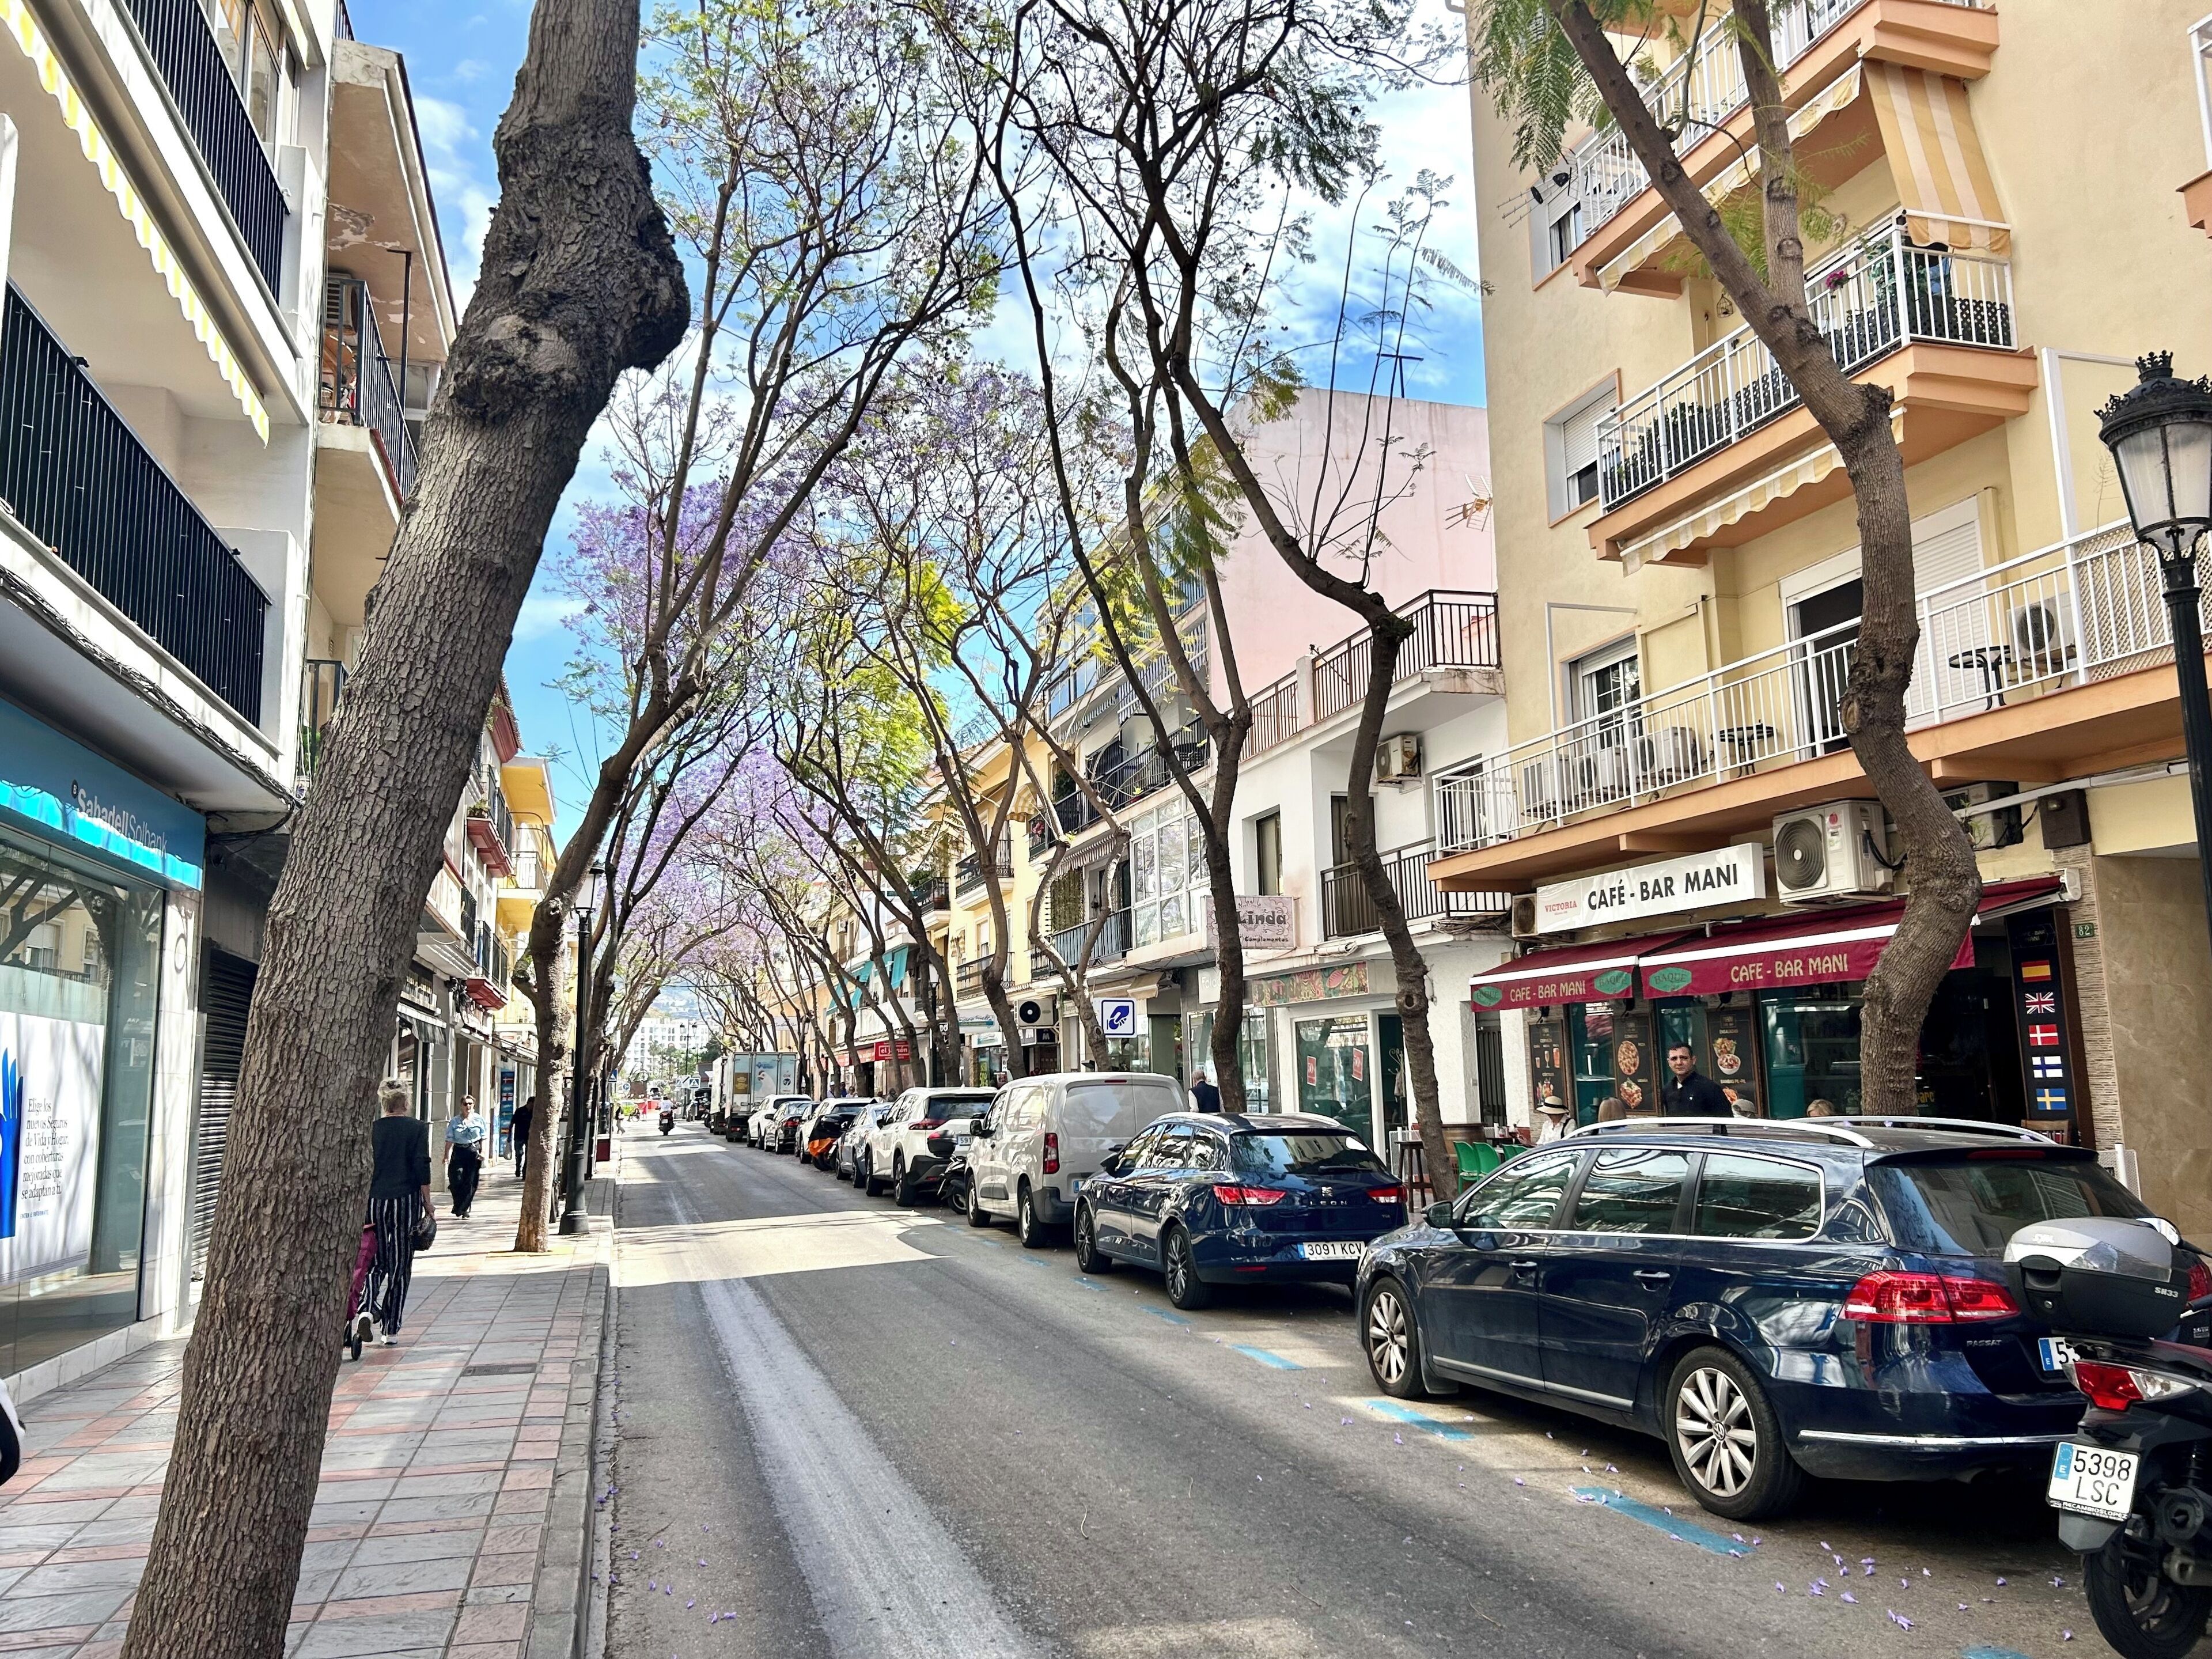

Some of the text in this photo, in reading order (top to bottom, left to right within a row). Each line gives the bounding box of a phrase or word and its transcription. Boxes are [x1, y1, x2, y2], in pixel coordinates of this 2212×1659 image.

[1588, 879, 1626, 910] CAFÉ
[1639, 876, 1675, 902] BAR
[1685, 863, 1738, 893] MANI
[1544, 900, 1578, 912] VICTORIA
[2078, 925, 2090, 936] 82
[1730, 963, 1764, 983] CAFE
[1775, 959, 1804, 979] BAR
[1808, 953, 1849, 975] MANI
[1510, 987, 1531, 1002] CAFE
[1538, 984, 1556, 999] BAR
[1559, 980, 1586, 997] MANI
[28, 1098, 51, 1116] Elige los
[26, 1116, 68, 1133] nuevos Seguros
[25, 1132, 33, 1147] de
[34, 1131, 47, 1146] Vida
[51, 1132, 69, 1148] Hogar,
[24, 1149, 63, 1164] con coberturas
[23, 1165, 62, 1184] mejoradas que
[22, 1189, 28, 1199] se
[29, 1183, 51, 1202] adaptan
[1308, 1243, 1362, 1256] 3091 KCV
[1966, 1339, 2003, 1348] PASSAT
[2059, 1464, 2067, 1474] E
[2074, 1449, 2131, 1482] 5398
[2075, 1476, 2120, 1506] LSC
